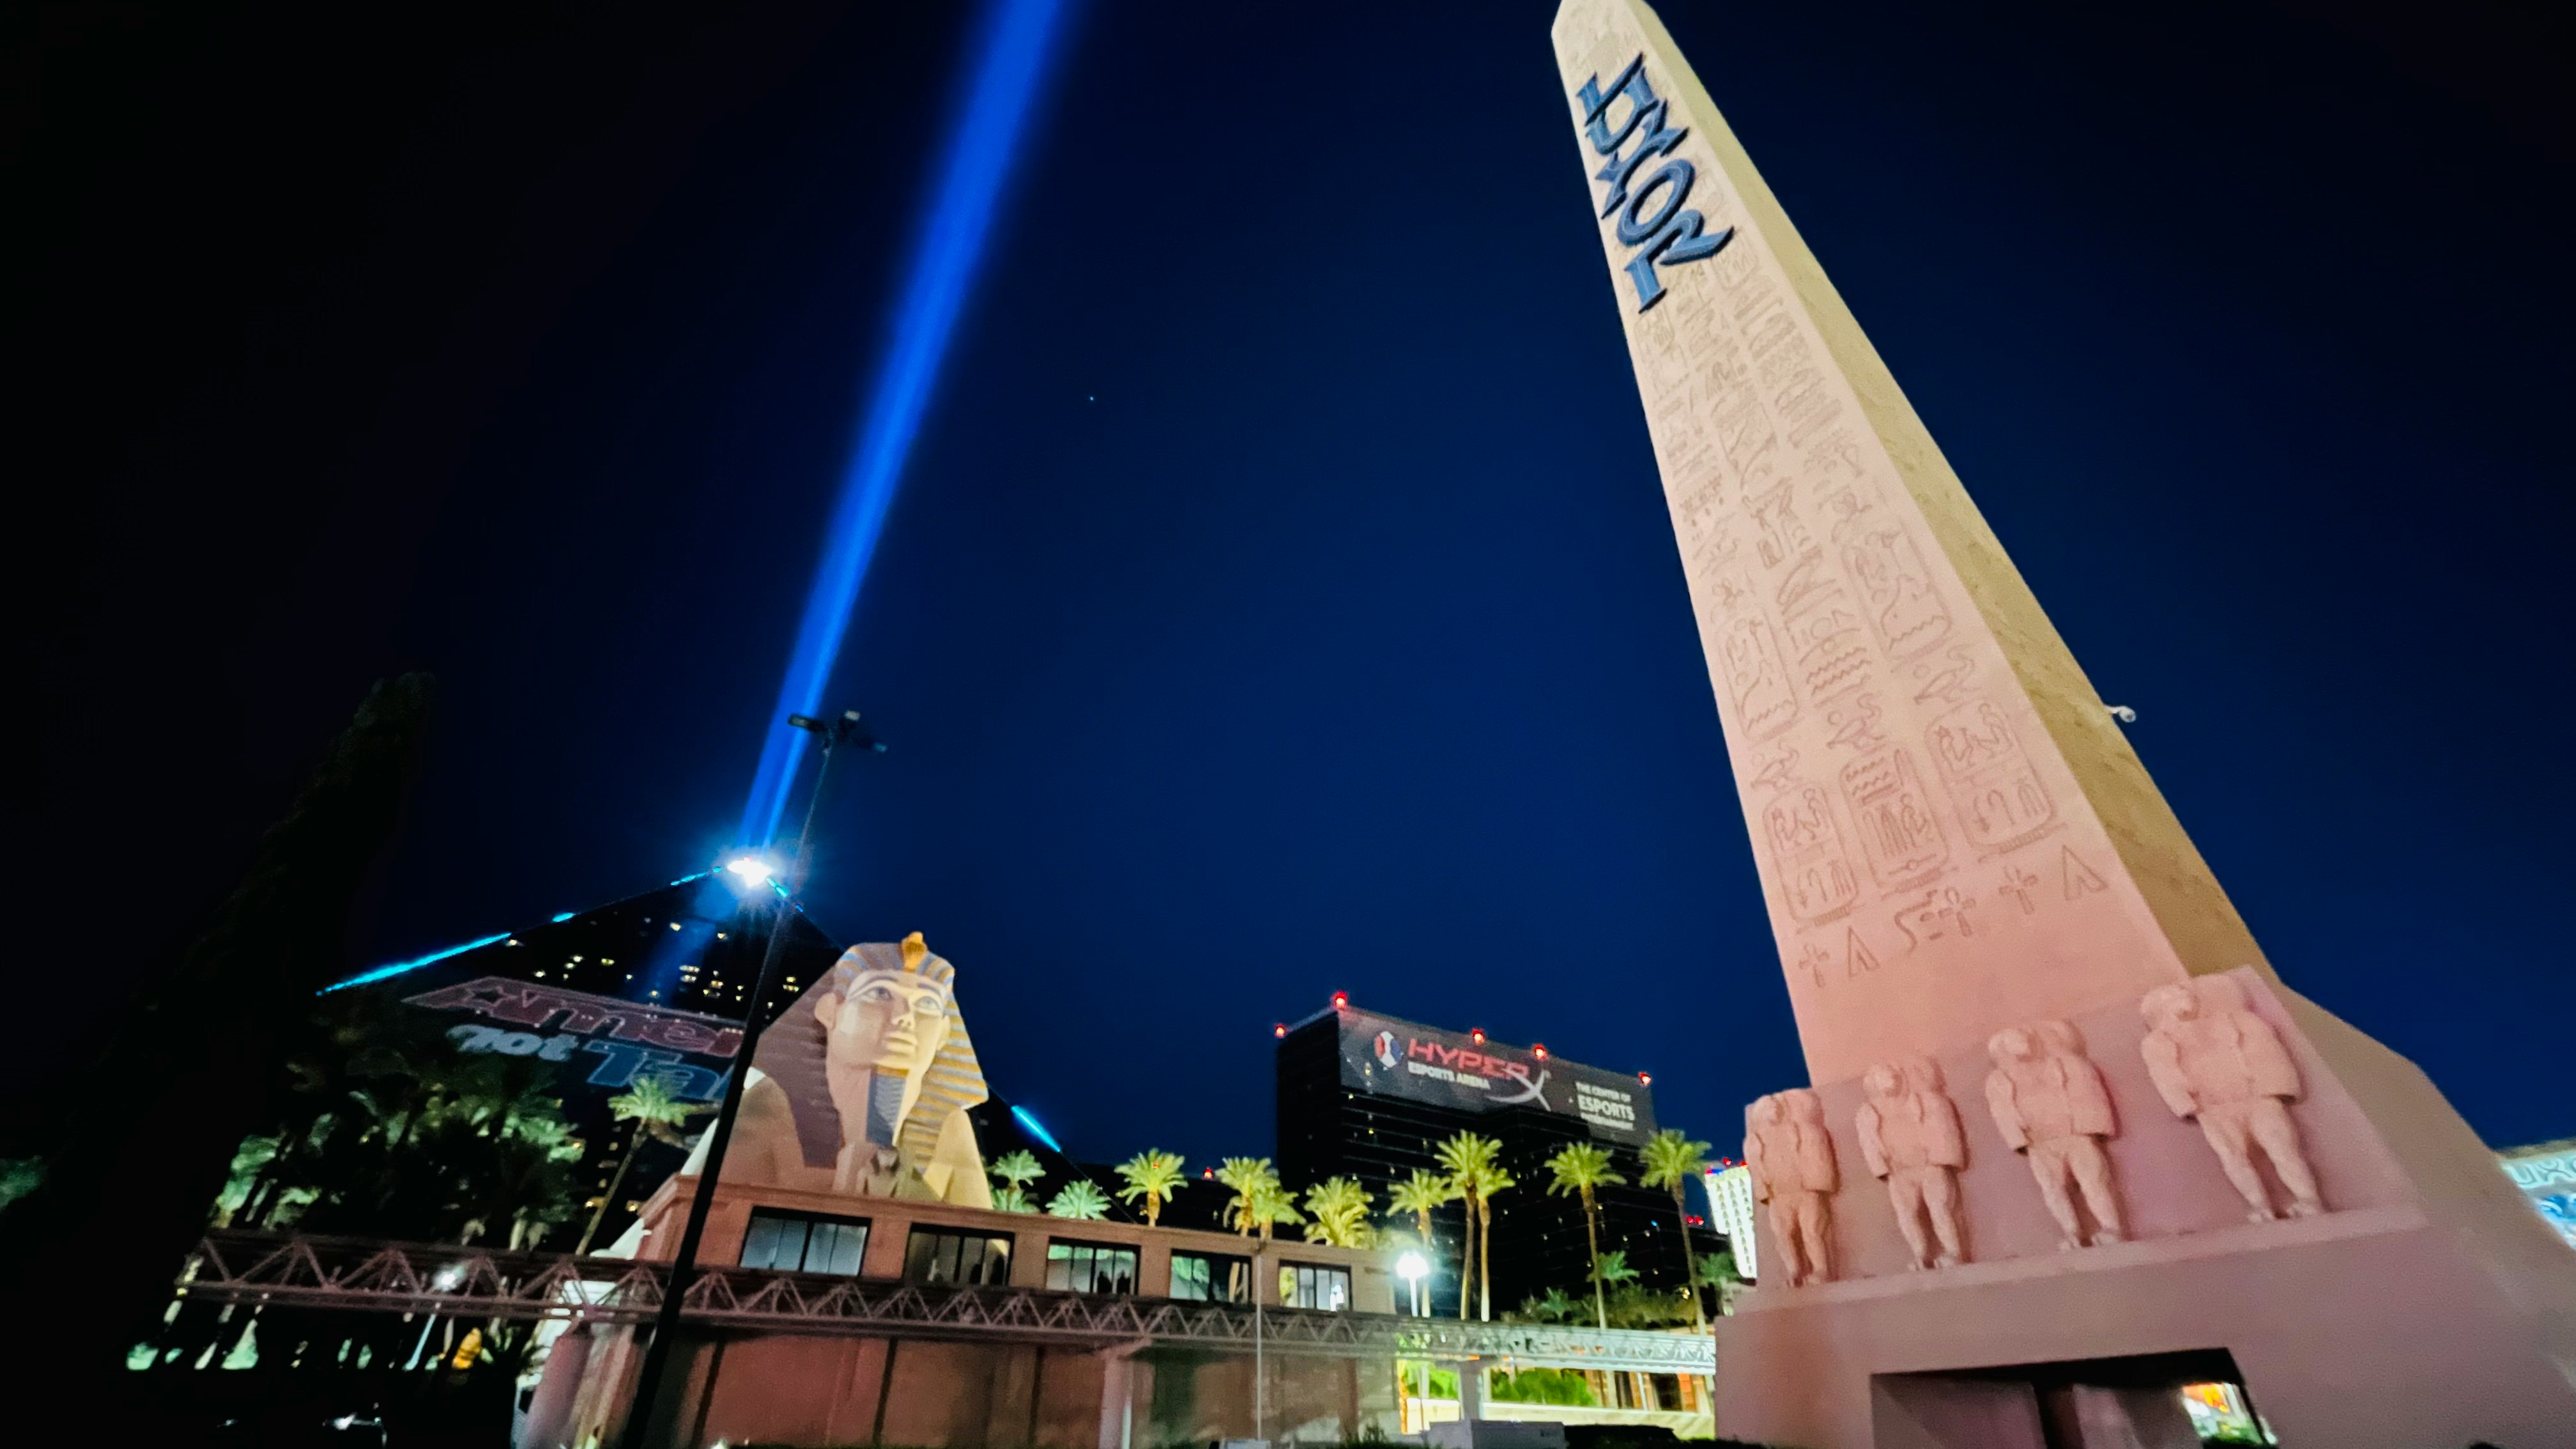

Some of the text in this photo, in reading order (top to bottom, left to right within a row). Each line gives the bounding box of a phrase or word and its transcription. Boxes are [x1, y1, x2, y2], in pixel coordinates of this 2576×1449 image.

[1576, 51, 1734, 314] LUXOR
[1407, 1061, 1491, 1090] ESPORTS ARENA
[1575, 1081, 1591, 1094] THE
[1591, 1085, 1620, 1100] CENTER
[1577, 1094, 1635, 1121] ESPORTS
